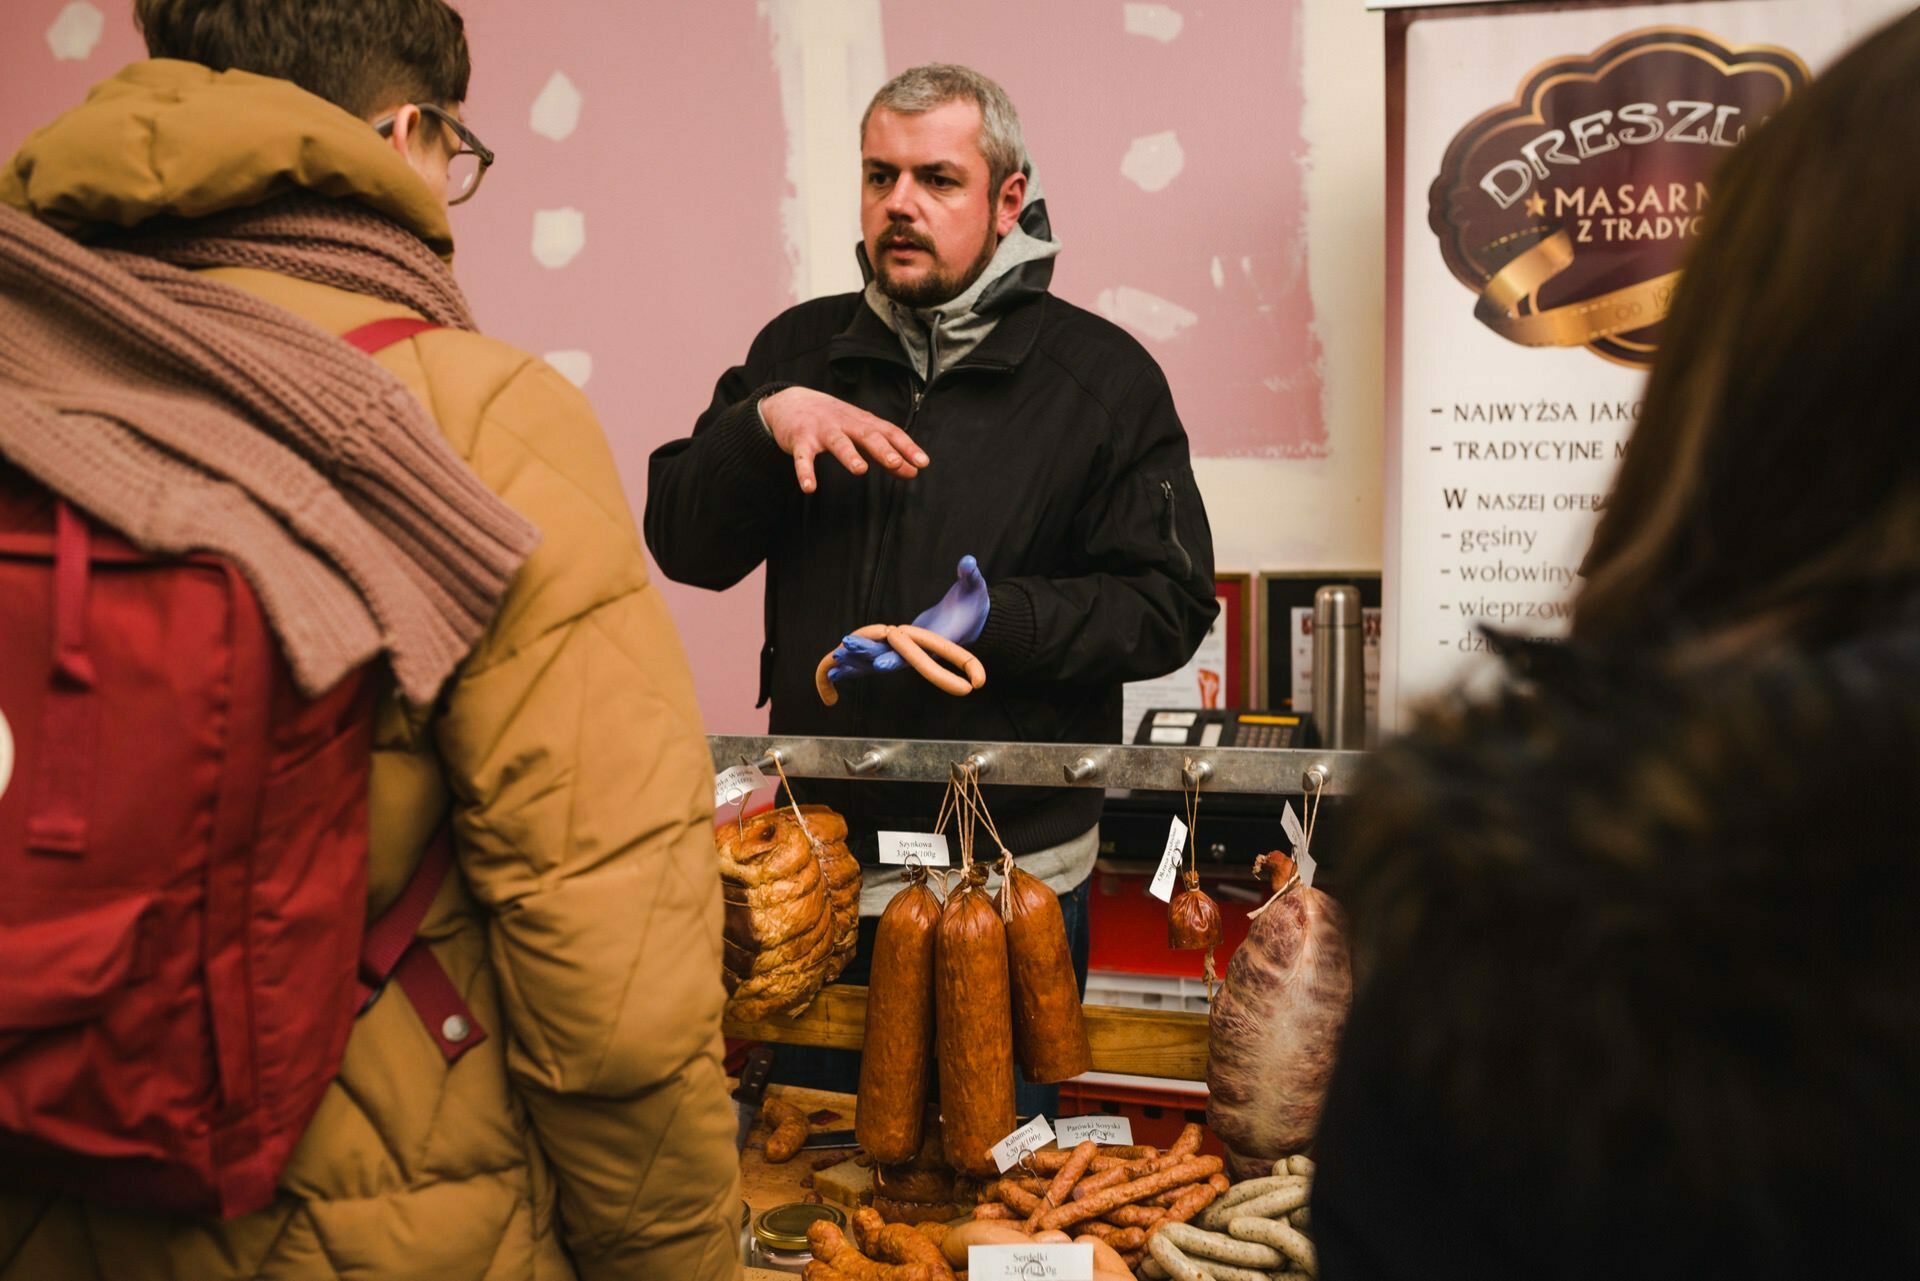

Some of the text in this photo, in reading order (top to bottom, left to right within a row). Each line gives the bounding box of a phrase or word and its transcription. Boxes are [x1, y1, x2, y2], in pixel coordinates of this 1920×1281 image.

[1479, 100, 1770, 211] DRESZL
[1577, 220, 1592, 243] Z
[1453, 398, 1578, 423] NAJWYŻSA
[1452, 441, 1603, 462] TRADYCYJNE
[1443, 487, 1467, 510] W
[1477, 493, 1545, 512] NASZEJ
[1459, 525, 1537, 553] gęsiny
[1459, 560, 1577, 588] wołowiny
[899, 840, 933, 849] Szynkowa
[1004, 1125, 1034, 1148] Kabanosy
